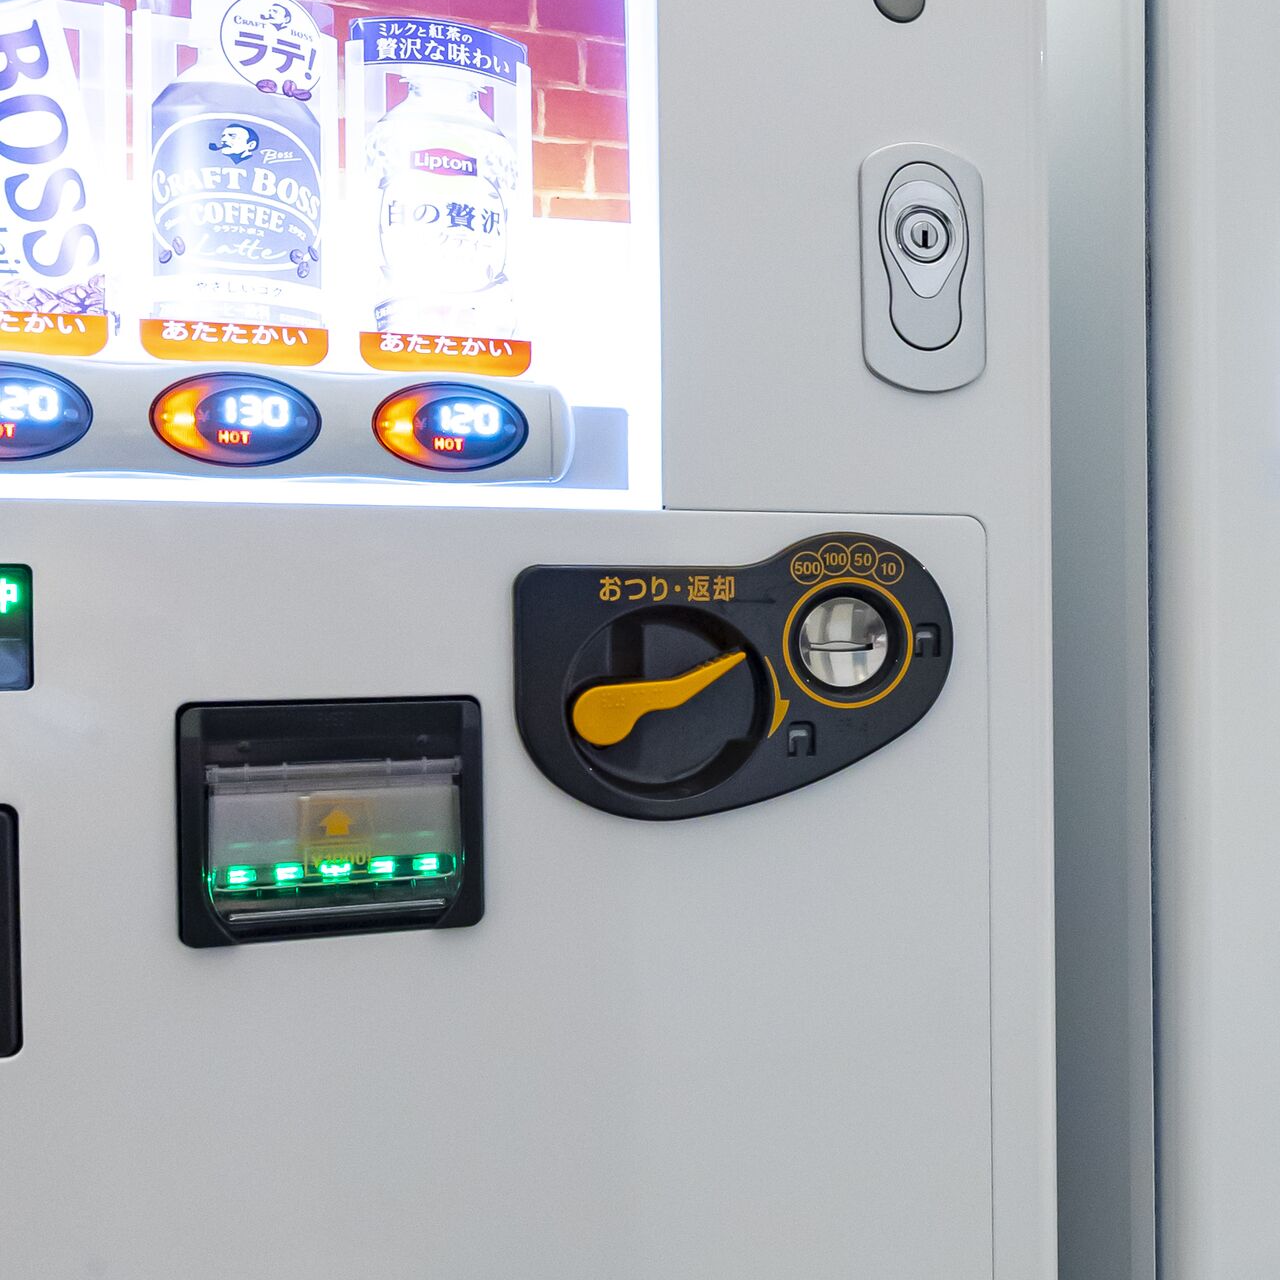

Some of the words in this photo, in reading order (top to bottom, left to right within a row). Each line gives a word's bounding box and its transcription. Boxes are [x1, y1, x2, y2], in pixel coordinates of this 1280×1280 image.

[378, 23, 473, 44] ミルクと紅茶の
[234, 31, 317, 80] ラテ!
[376, 38, 510, 73] 贅沢な味わい
[414, 153, 474, 173] Lipton
[152, 167, 247, 205] CRAFT
[252, 167, 321, 220] BOSS
[190, 201, 287, 233] COFFEE
[387, 201, 502, 236] 白の贅沢
[162, 320, 309, 347] あたたかい
[379, 332, 513, 358] あたたかい
[224, 394, 291, 425] 130
[438, 403, 501, 435] 120
[218, 430, 251, 447] HOT
[434, 437, 464, 452] HOT
[793, 561, 822, 576] 500
[823, 551, 848, 568] 100
[853, 552, 873, 568] 50
[880, 562, 896, 576] 10
[599, 576, 736, 603] おつり・返却
